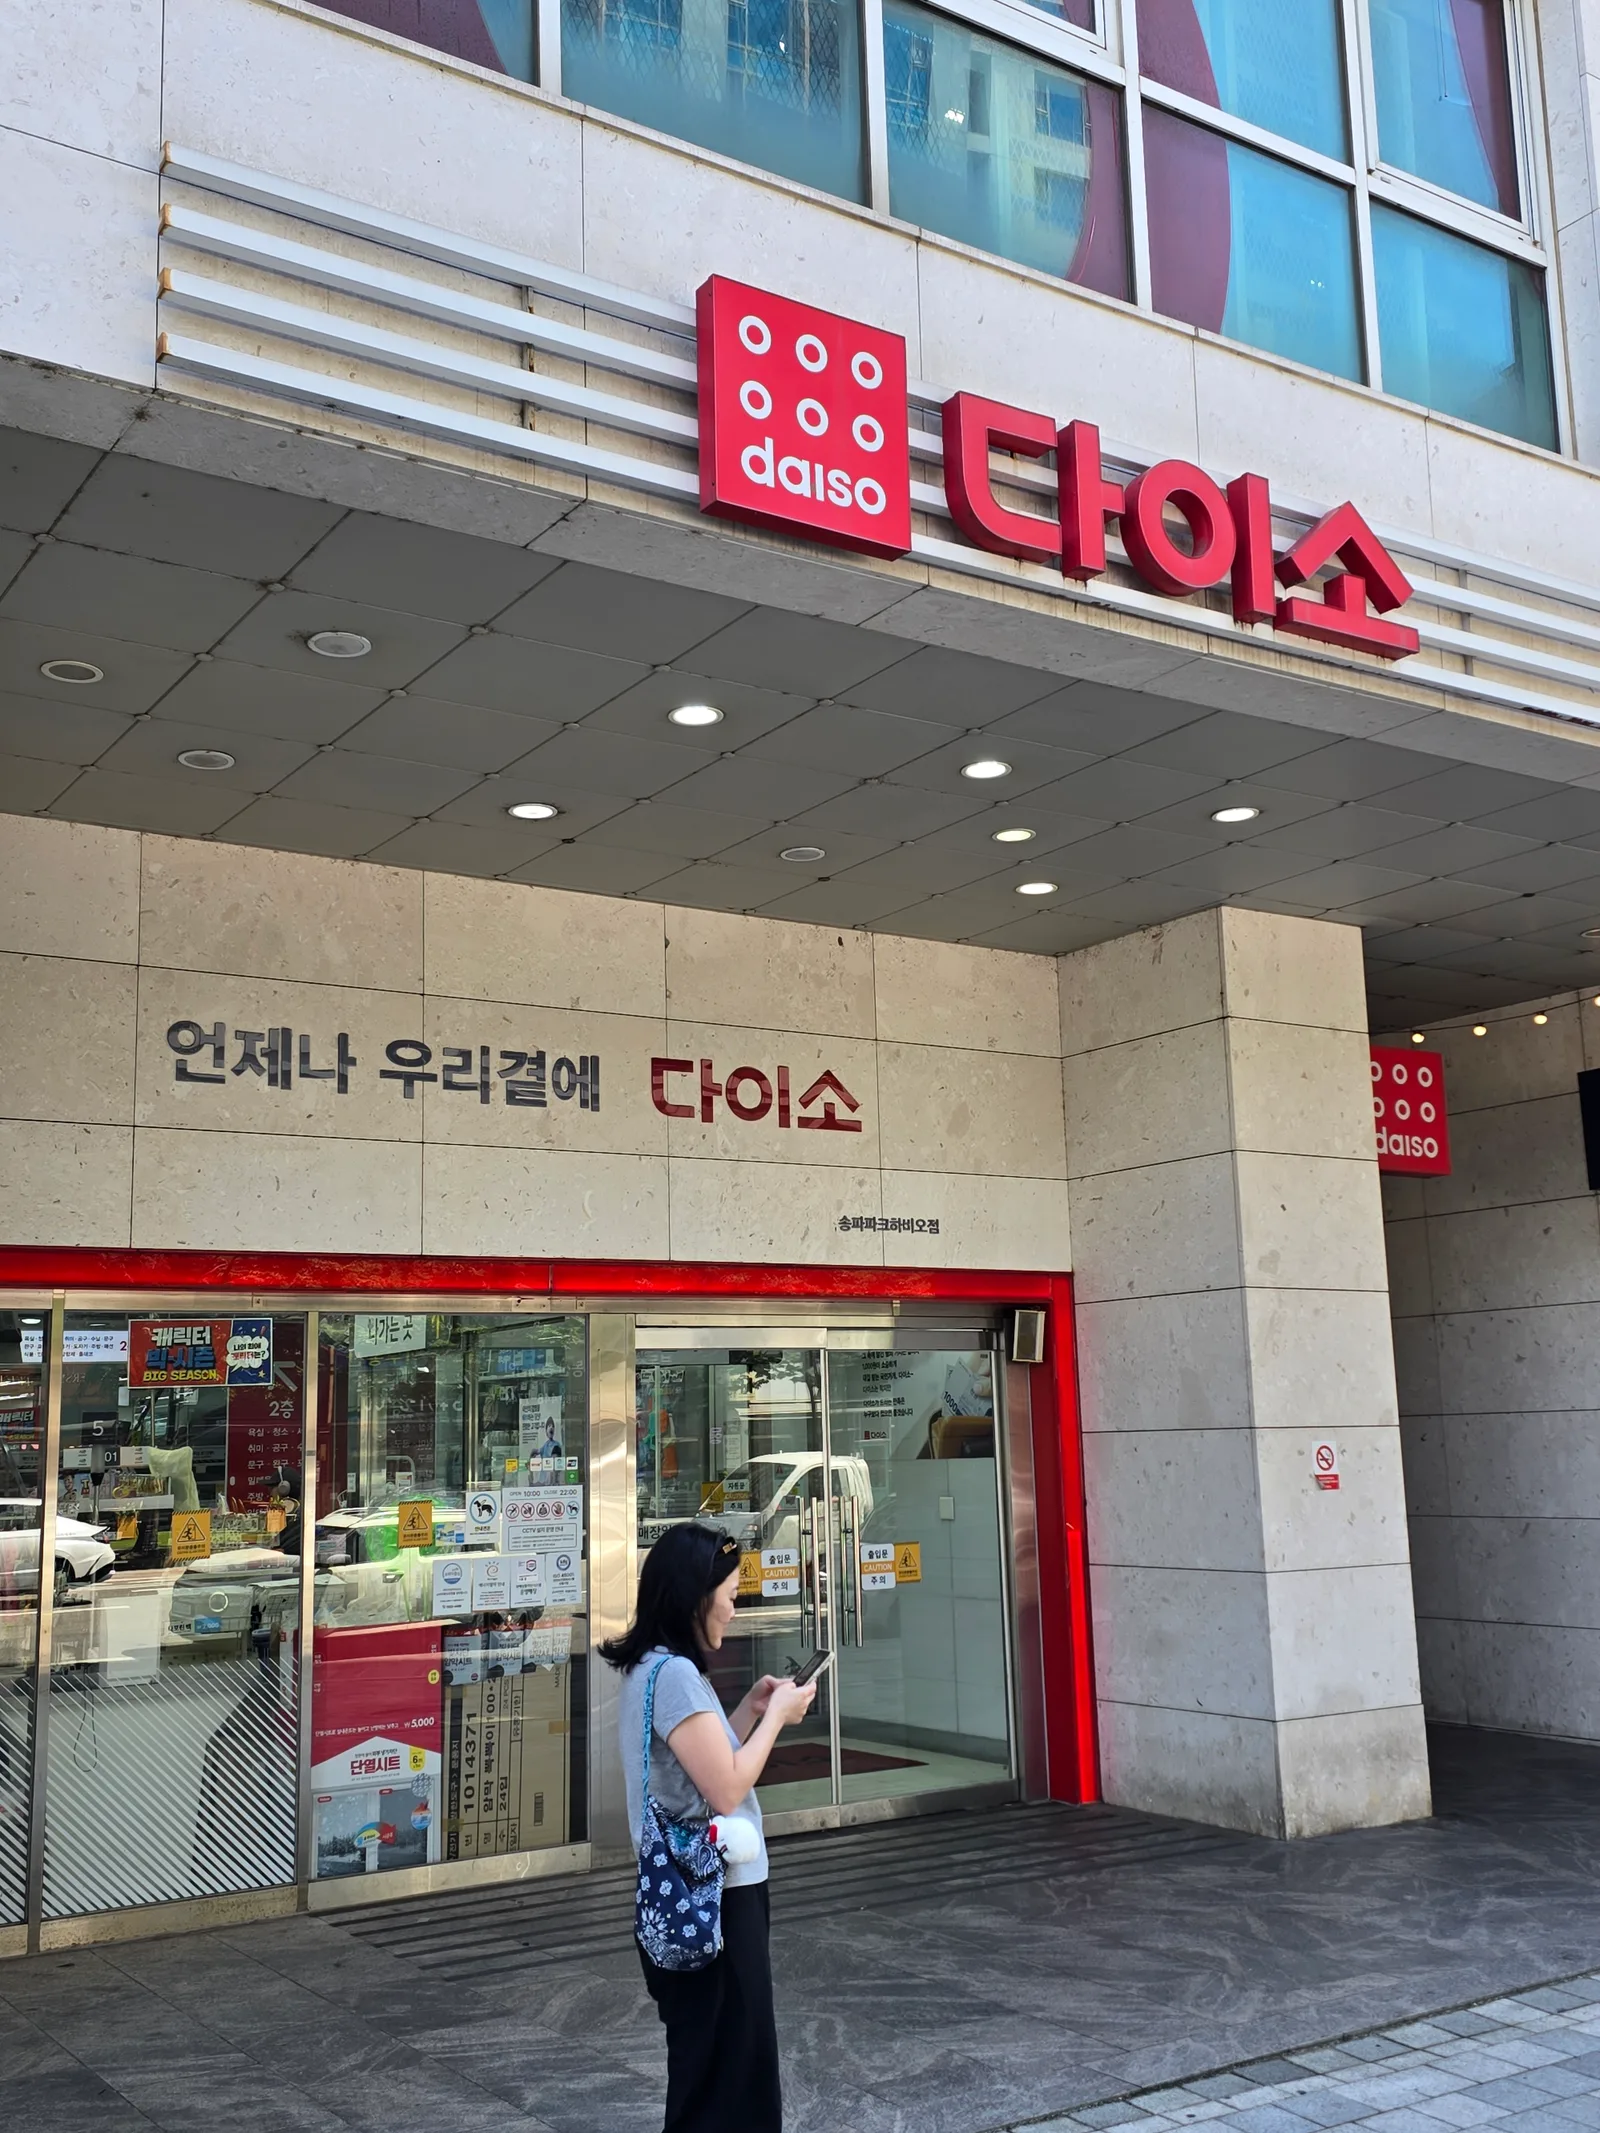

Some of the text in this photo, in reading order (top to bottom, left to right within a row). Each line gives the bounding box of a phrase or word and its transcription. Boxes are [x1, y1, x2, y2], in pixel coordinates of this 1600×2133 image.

[740, 437, 887, 516] daiso
[942, 390, 1420, 660] 다이소
[165, 1017, 863, 1134] 언제나 우리곁에 다이소
[1375, 1126, 1439, 1159] daiso
[838, 1215, 940, 1234] 송파파크하비오점
[152, 1326, 211, 1347] 캐릭터
[403, 1314, 413, 1341] 곳
[143, 1369, 217, 1381] BIG SEASON
[269, 1400, 295, 1419] 2층
[92, 1420, 105, 1437] 5
[248, 1427, 265, 1437] 욕실
[272, 1427, 289, 1436] 청소
[104, 1451, 117, 1462] 01
[248, 1444, 264, 1454] 취미
[272, 1443, 289, 1453] 공구
[247, 1492, 264, 1503] 주방
[522, 1526, 536, 1534] CCTV
[768, 1554, 791, 1565] 출입문
[867, 1549, 888, 1560] 출입문
[764, 1569, 795, 1578] CAUTION
[863, 1563, 893, 1572] CAUTION
[350, 1756, 401, 1776] 단열시트
[463, 1712, 477, 1814] 1014371
[484, 1780, 494, 1813] 암막
[500, 1776, 508, 1811] 24입
